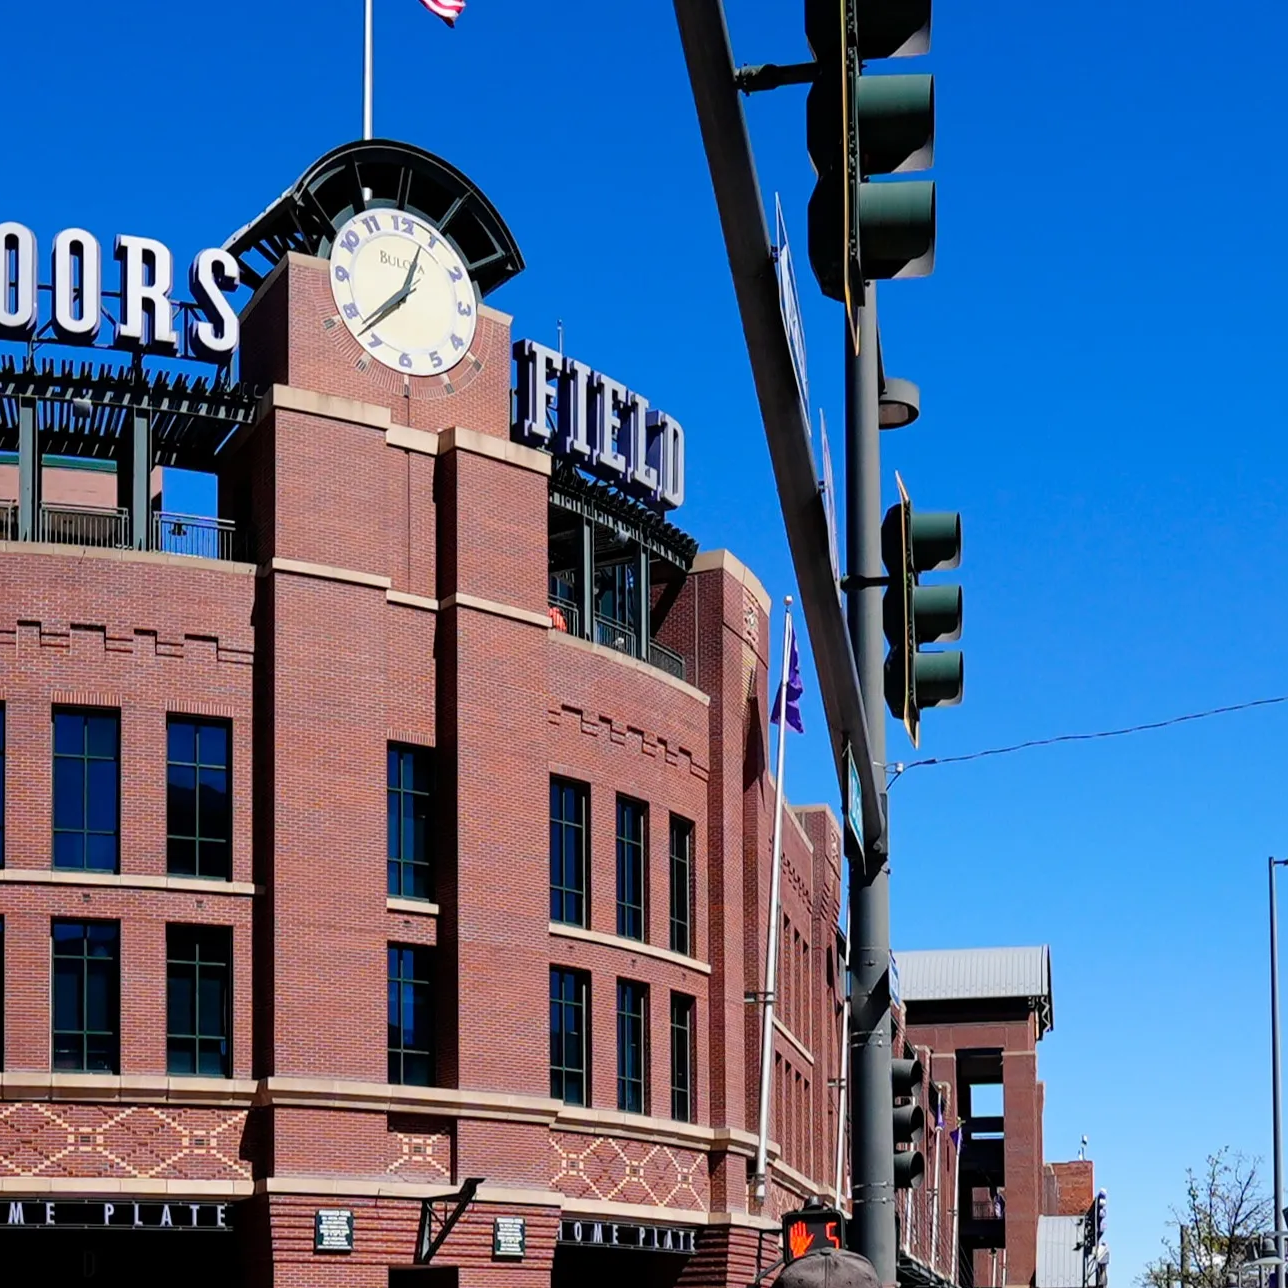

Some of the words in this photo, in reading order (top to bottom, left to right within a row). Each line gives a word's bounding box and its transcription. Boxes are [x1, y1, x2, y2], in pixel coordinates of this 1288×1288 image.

[362, 216, 381, 234] 11
[391, 215, 415, 236] 12
[339, 230, 361, 254] 10
[428, 235, 439, 249] 1
[379, 250, 425, 276] BULOA
[335, 265, 350, 283] 9
[447, 266, 463, 282] 2
[343, 303, 360, 320] 8
[458, 301, 471, 317] 3
[367, 332, 383, 349] 7
[450, 333, 464, 351] 4
[398, 353, 412, 369] 6
[429, 351, 443, 368] 5
[525, 339, 685, 507] FIELD
[104, 1203, 227, 1227] PLATE
[638, 1226, 696, 1251] PLATE
[825, 1222, 840, 1250] 5
